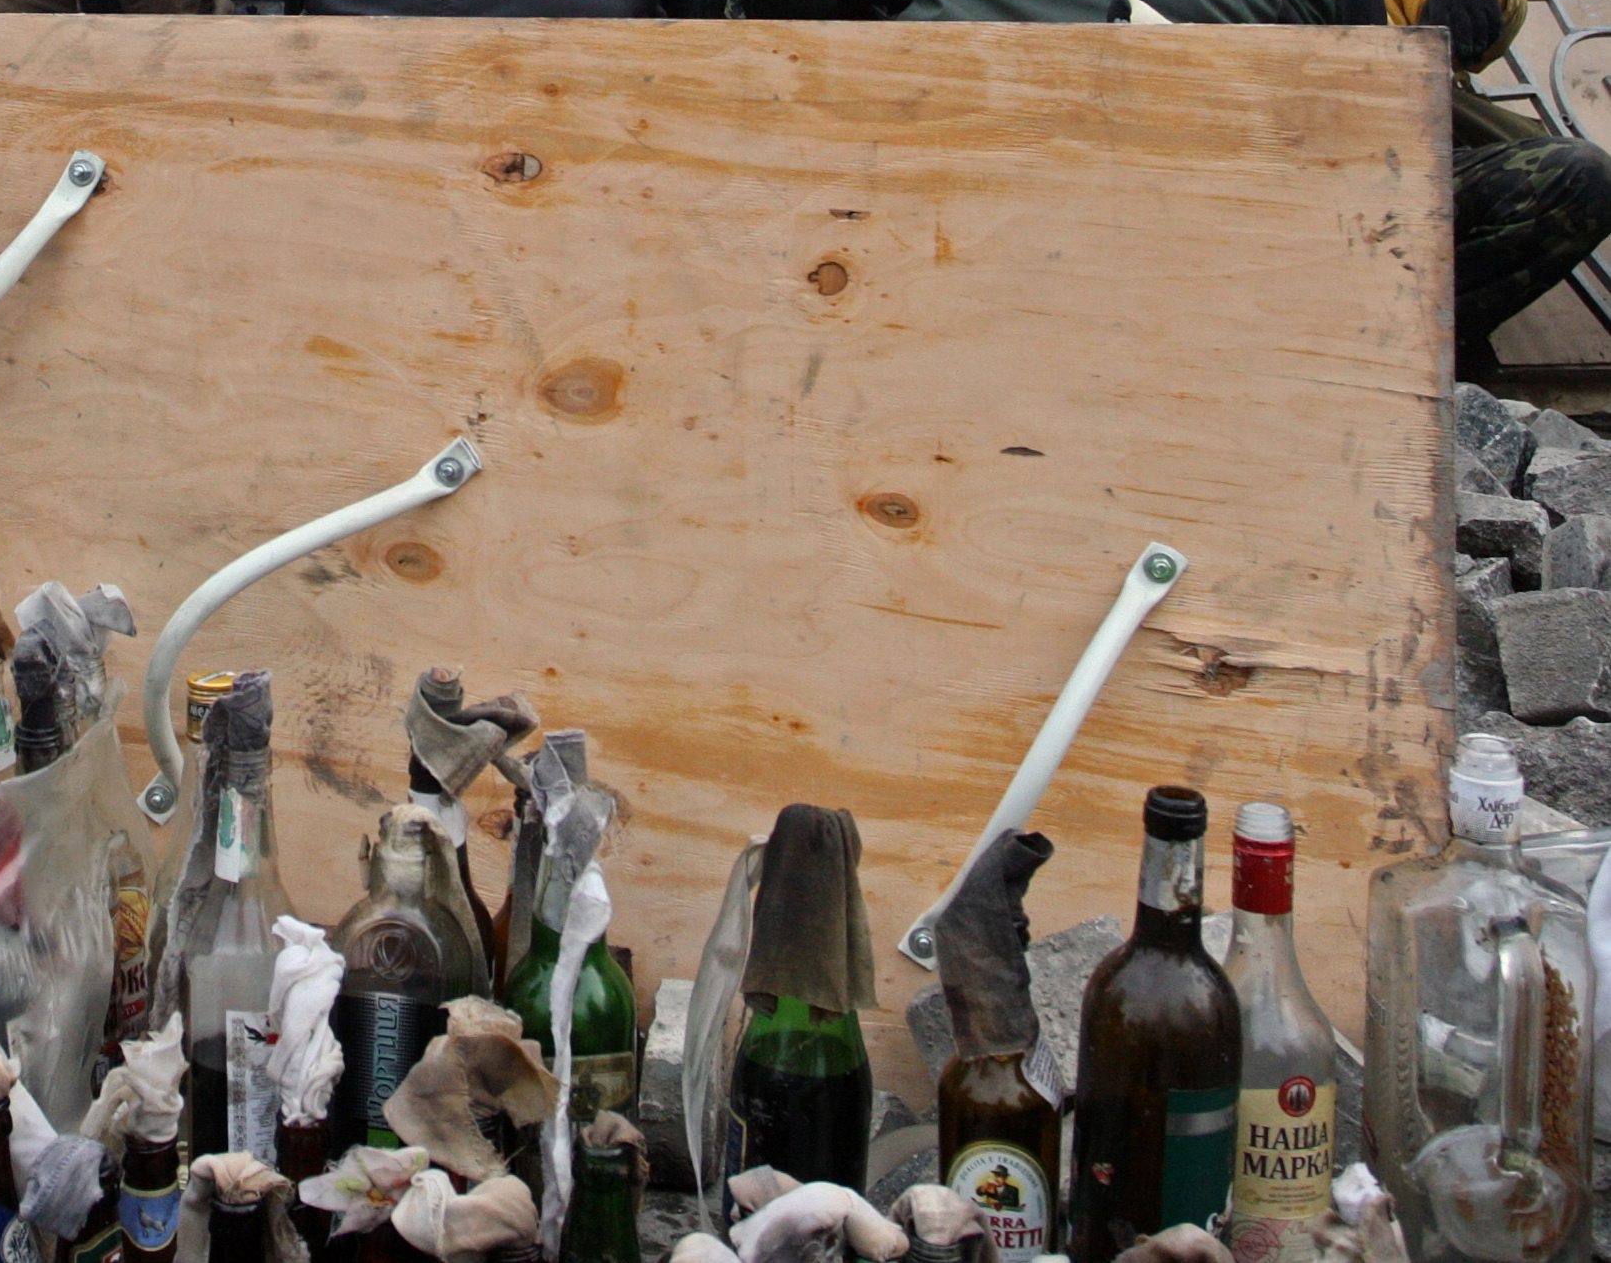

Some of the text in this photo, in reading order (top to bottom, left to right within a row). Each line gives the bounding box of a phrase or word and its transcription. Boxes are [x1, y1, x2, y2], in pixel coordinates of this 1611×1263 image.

[1489, 813, 1514, 830] Дар
[1249, 1121, 1329, 1151] НАША
[1242, 1149, 1330, 1180] МАРКА
[990, 1217, 1026, 1229] RRA
[991, 1227, 1043, 1249] RETTI
